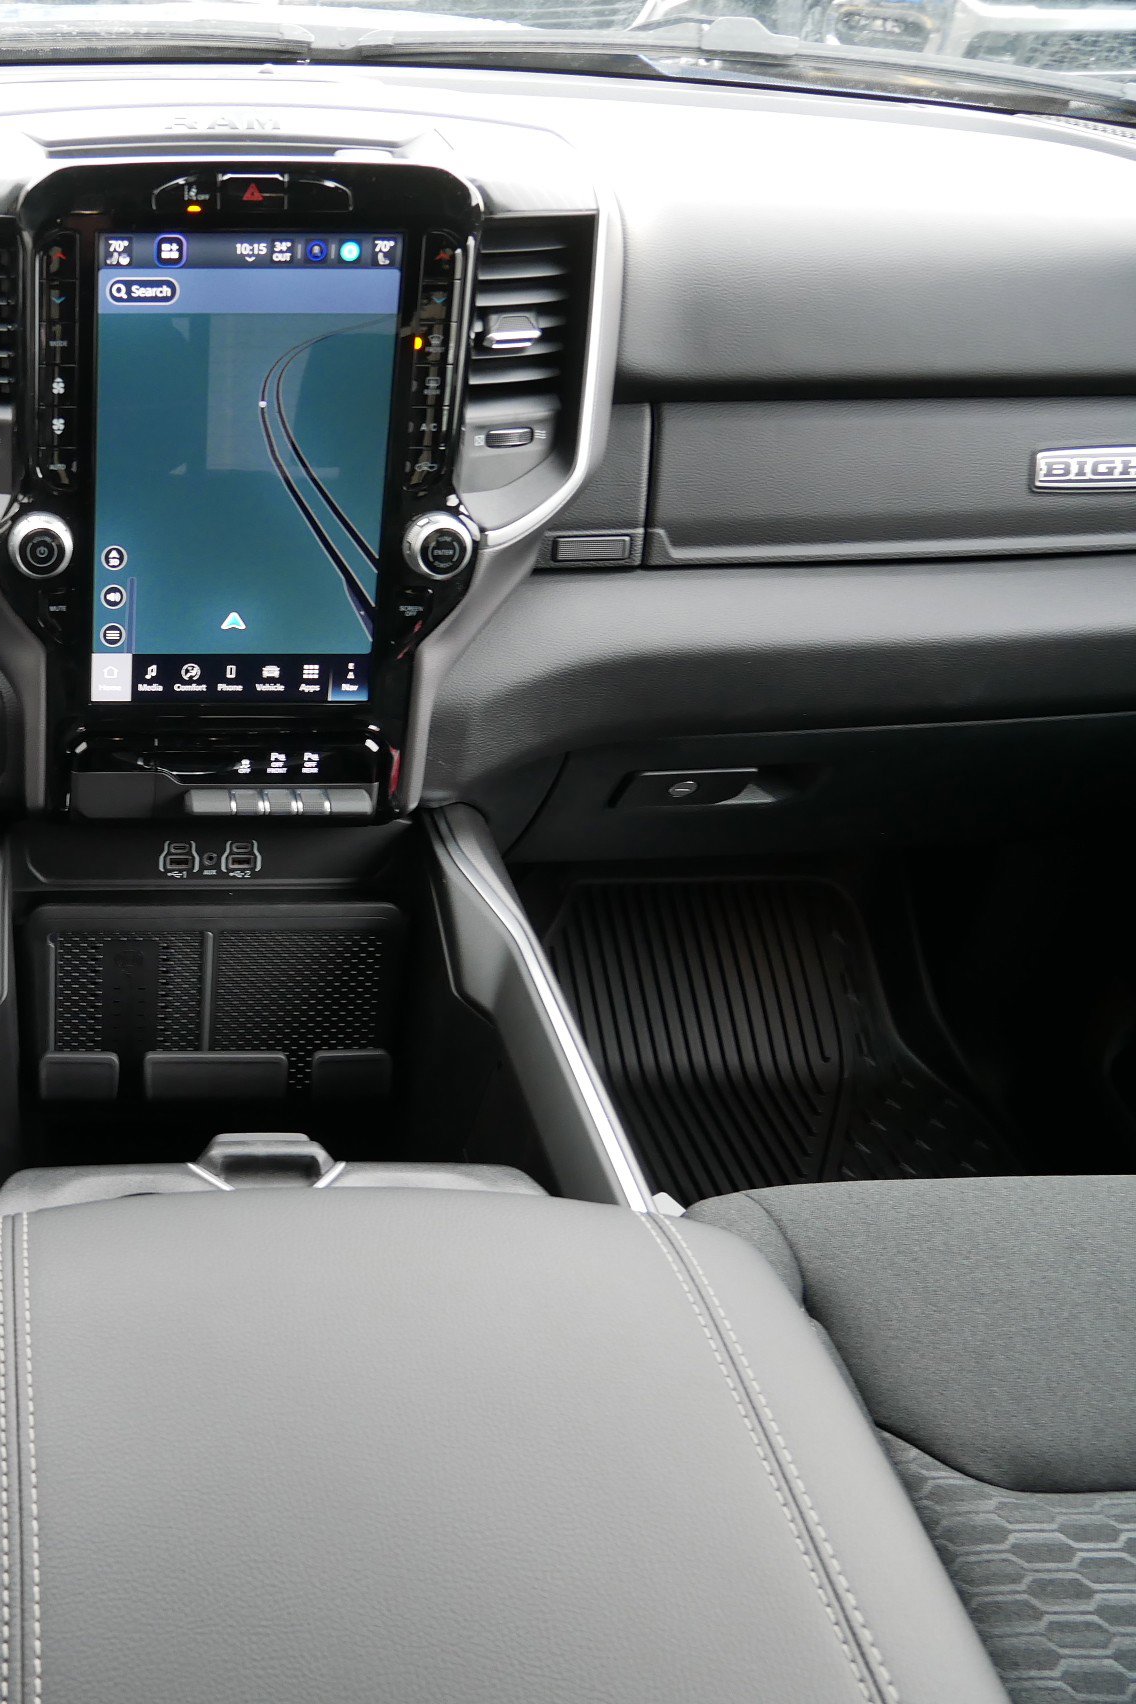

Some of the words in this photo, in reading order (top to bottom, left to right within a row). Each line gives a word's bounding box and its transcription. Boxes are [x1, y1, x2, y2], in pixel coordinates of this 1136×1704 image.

[165, 118, 280, 129] RAM
[236, 243, 267, 255] 10:15
[272, 253, 291, 262] OUT
[131, 285, 171, 297] Search
[137, 683, 164, 692] Media
[173, 683, 207, 692] Comfort
[217, 683, 244, 692] Phone
[255, 683, 285, 692] Vehicle
[298, 683, 321, 693] Apps
[341, 683, 359, 691] Nav
